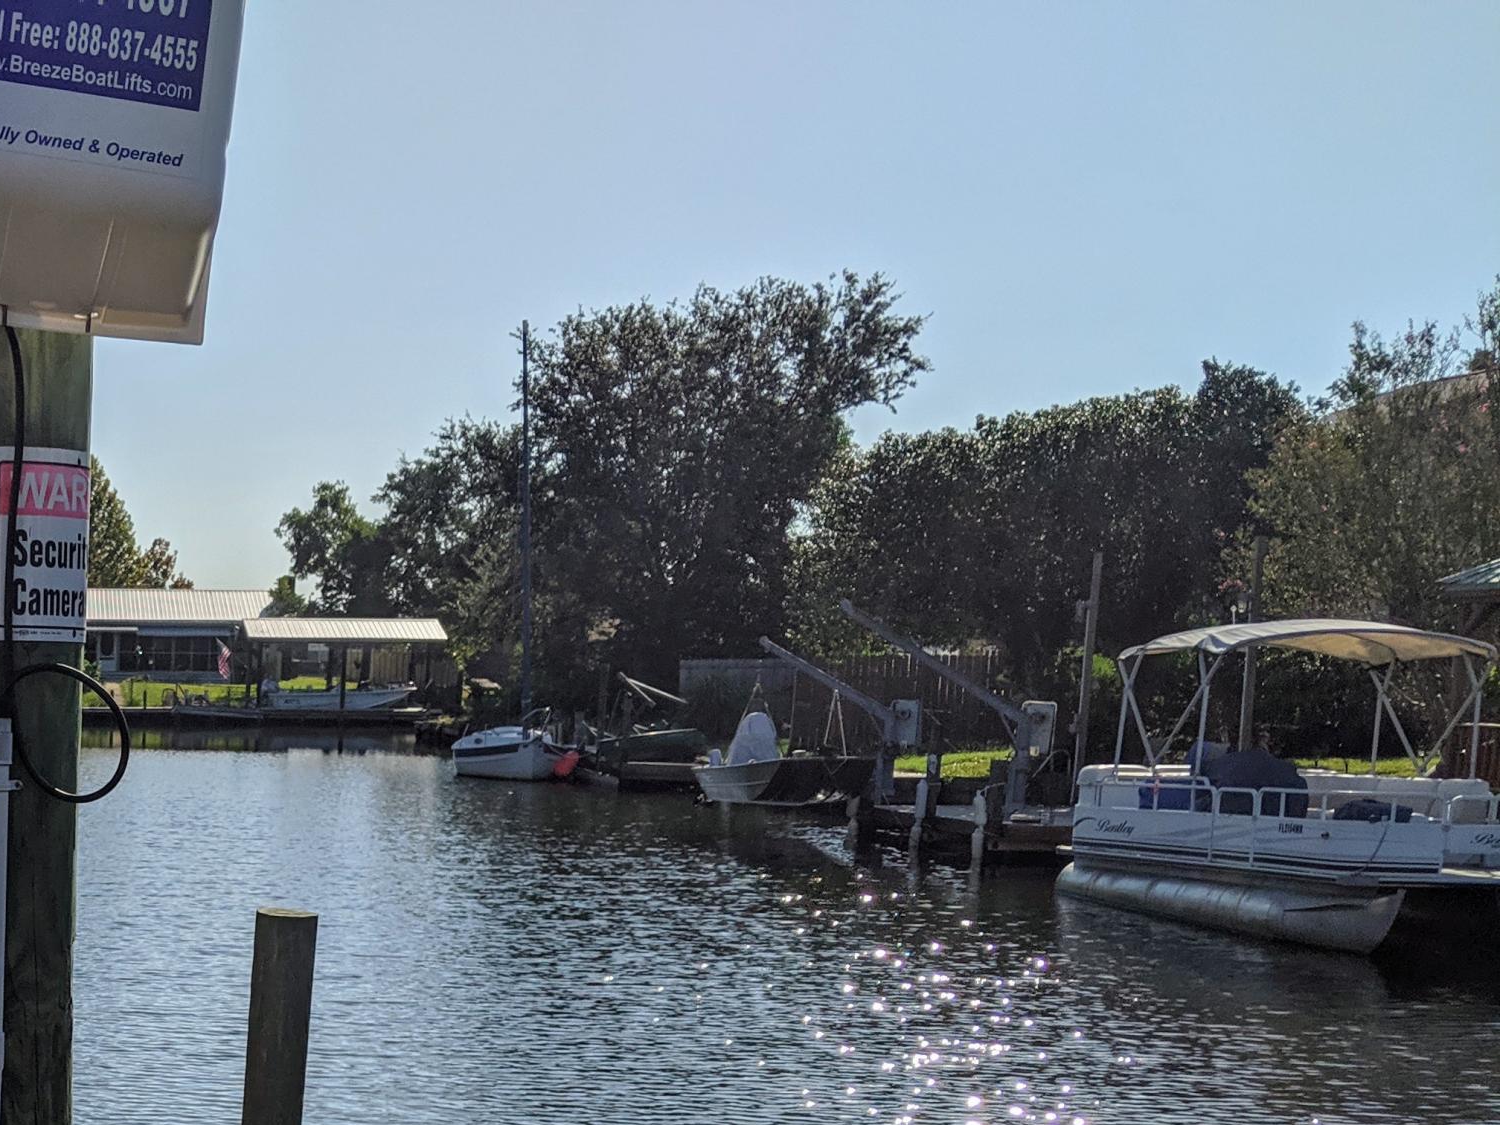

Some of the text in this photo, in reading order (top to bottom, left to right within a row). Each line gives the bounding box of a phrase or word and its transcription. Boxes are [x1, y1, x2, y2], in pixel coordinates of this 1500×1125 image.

[10, 12, 61, 49] Free:
[65, 20, 198, 71] 888-837-4555
[25, 130, 85, 152] Owned
[88, 139, 101, 154] &
[106, 142, 184, 167] Operated
